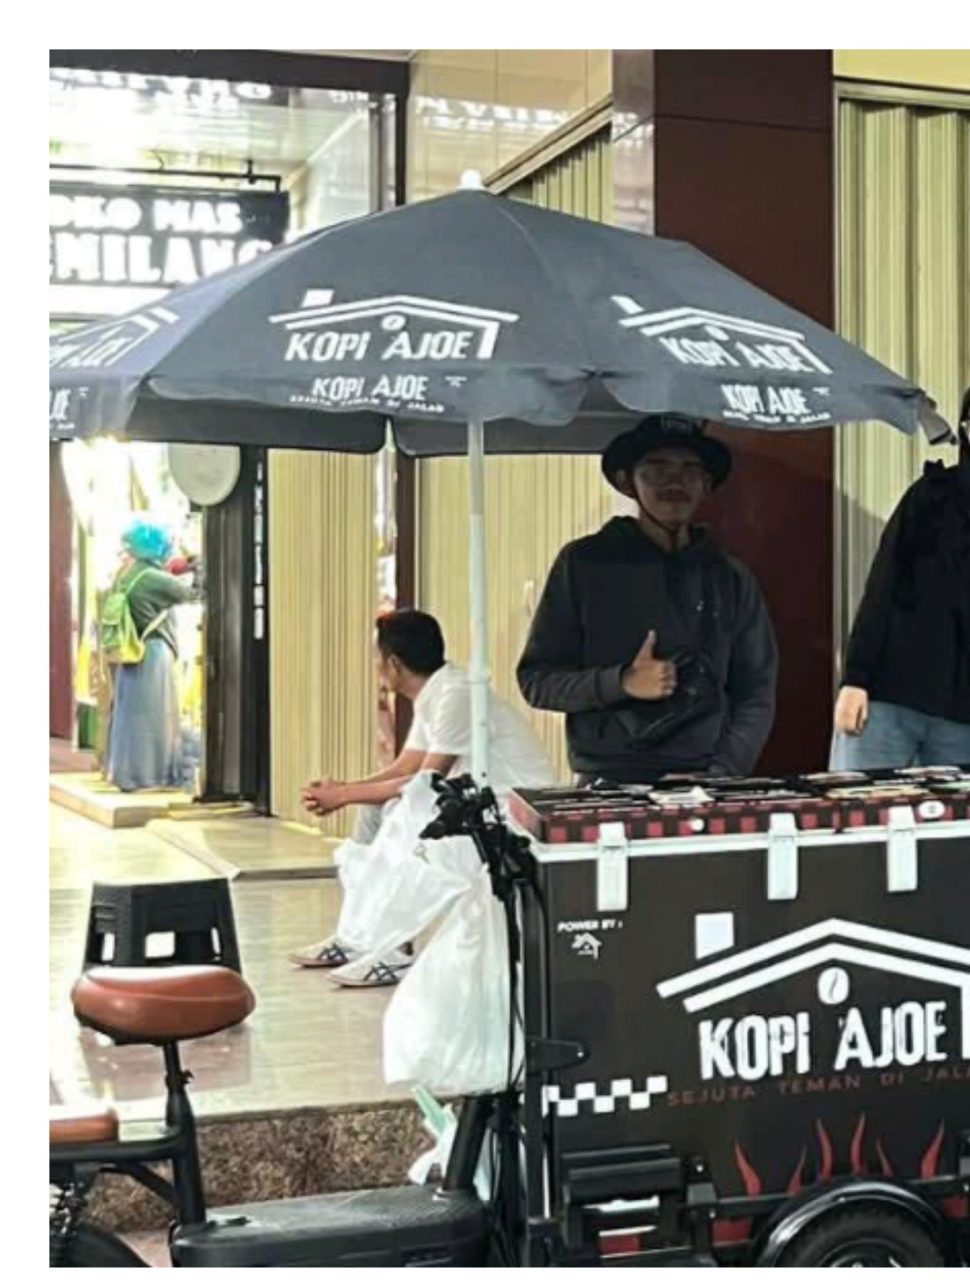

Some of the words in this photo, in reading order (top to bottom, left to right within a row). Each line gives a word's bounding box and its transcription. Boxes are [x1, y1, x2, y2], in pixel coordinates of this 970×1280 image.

[153, 198, 243, 234] MAS
[284, 331, 372, 363] KOPI
[381, 331, 474, 361] AJOE
[312, 376, 365, 402] KOPI
[371, 374, 429, 402] AJOE
[557, 920, 599, 933] POWER
[697, 1012, 812, 1082] KOPI
[834, 1000, 949, 1072] AJOE
[667, 1085, 756, 1107] SEJUTA
[779, 1077, 862, 1096] TEMAN
[880, 1073, 905, 1088] DI
